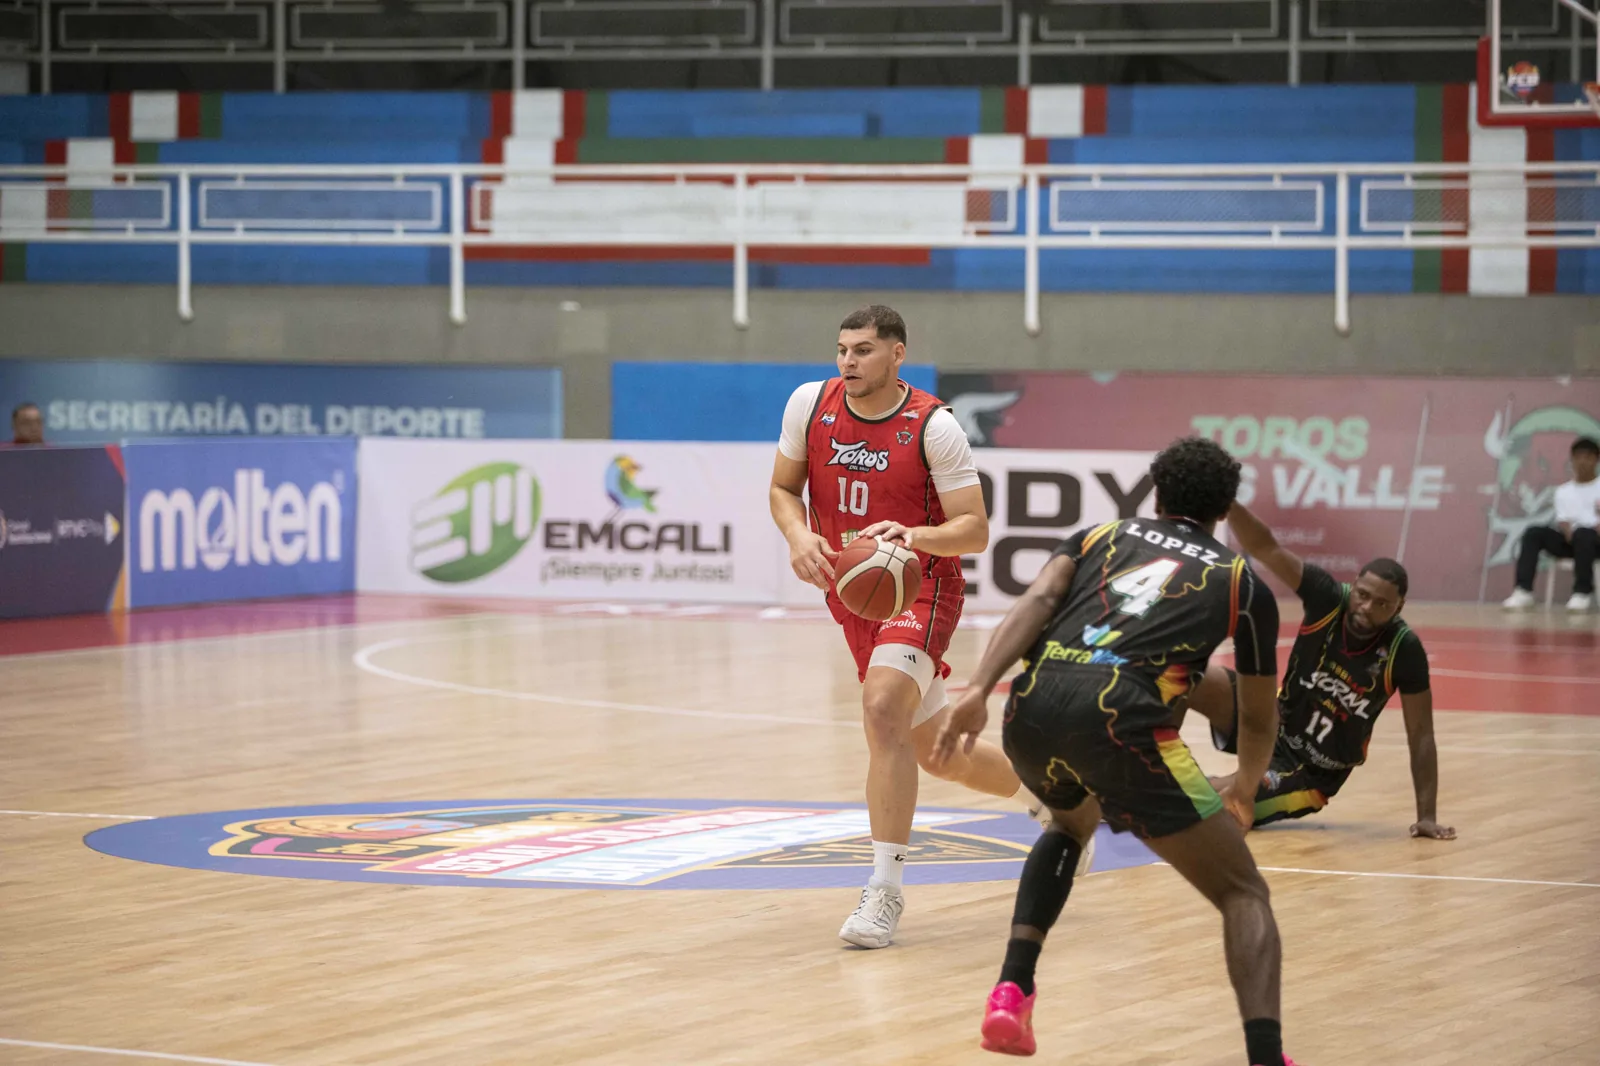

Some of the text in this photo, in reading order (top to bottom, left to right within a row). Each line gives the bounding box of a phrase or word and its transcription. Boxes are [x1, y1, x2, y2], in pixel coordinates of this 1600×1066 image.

[48, 395, 486, 438] SECRETARÍA DEL DEPORTE
[1190, 415, 1370, 460] TOROS
[837, 476, 869, 516] 10
[1272, 465, 1446, 509] VALLE
[139, 468, 341, 573] molten
[544, 520, 732, 552] EMCALI
[1126, 523, 1219, 566] LOPEZ
[1110, 558, 1180, 616] 4
[1305, 710, 1333, 744] 17
